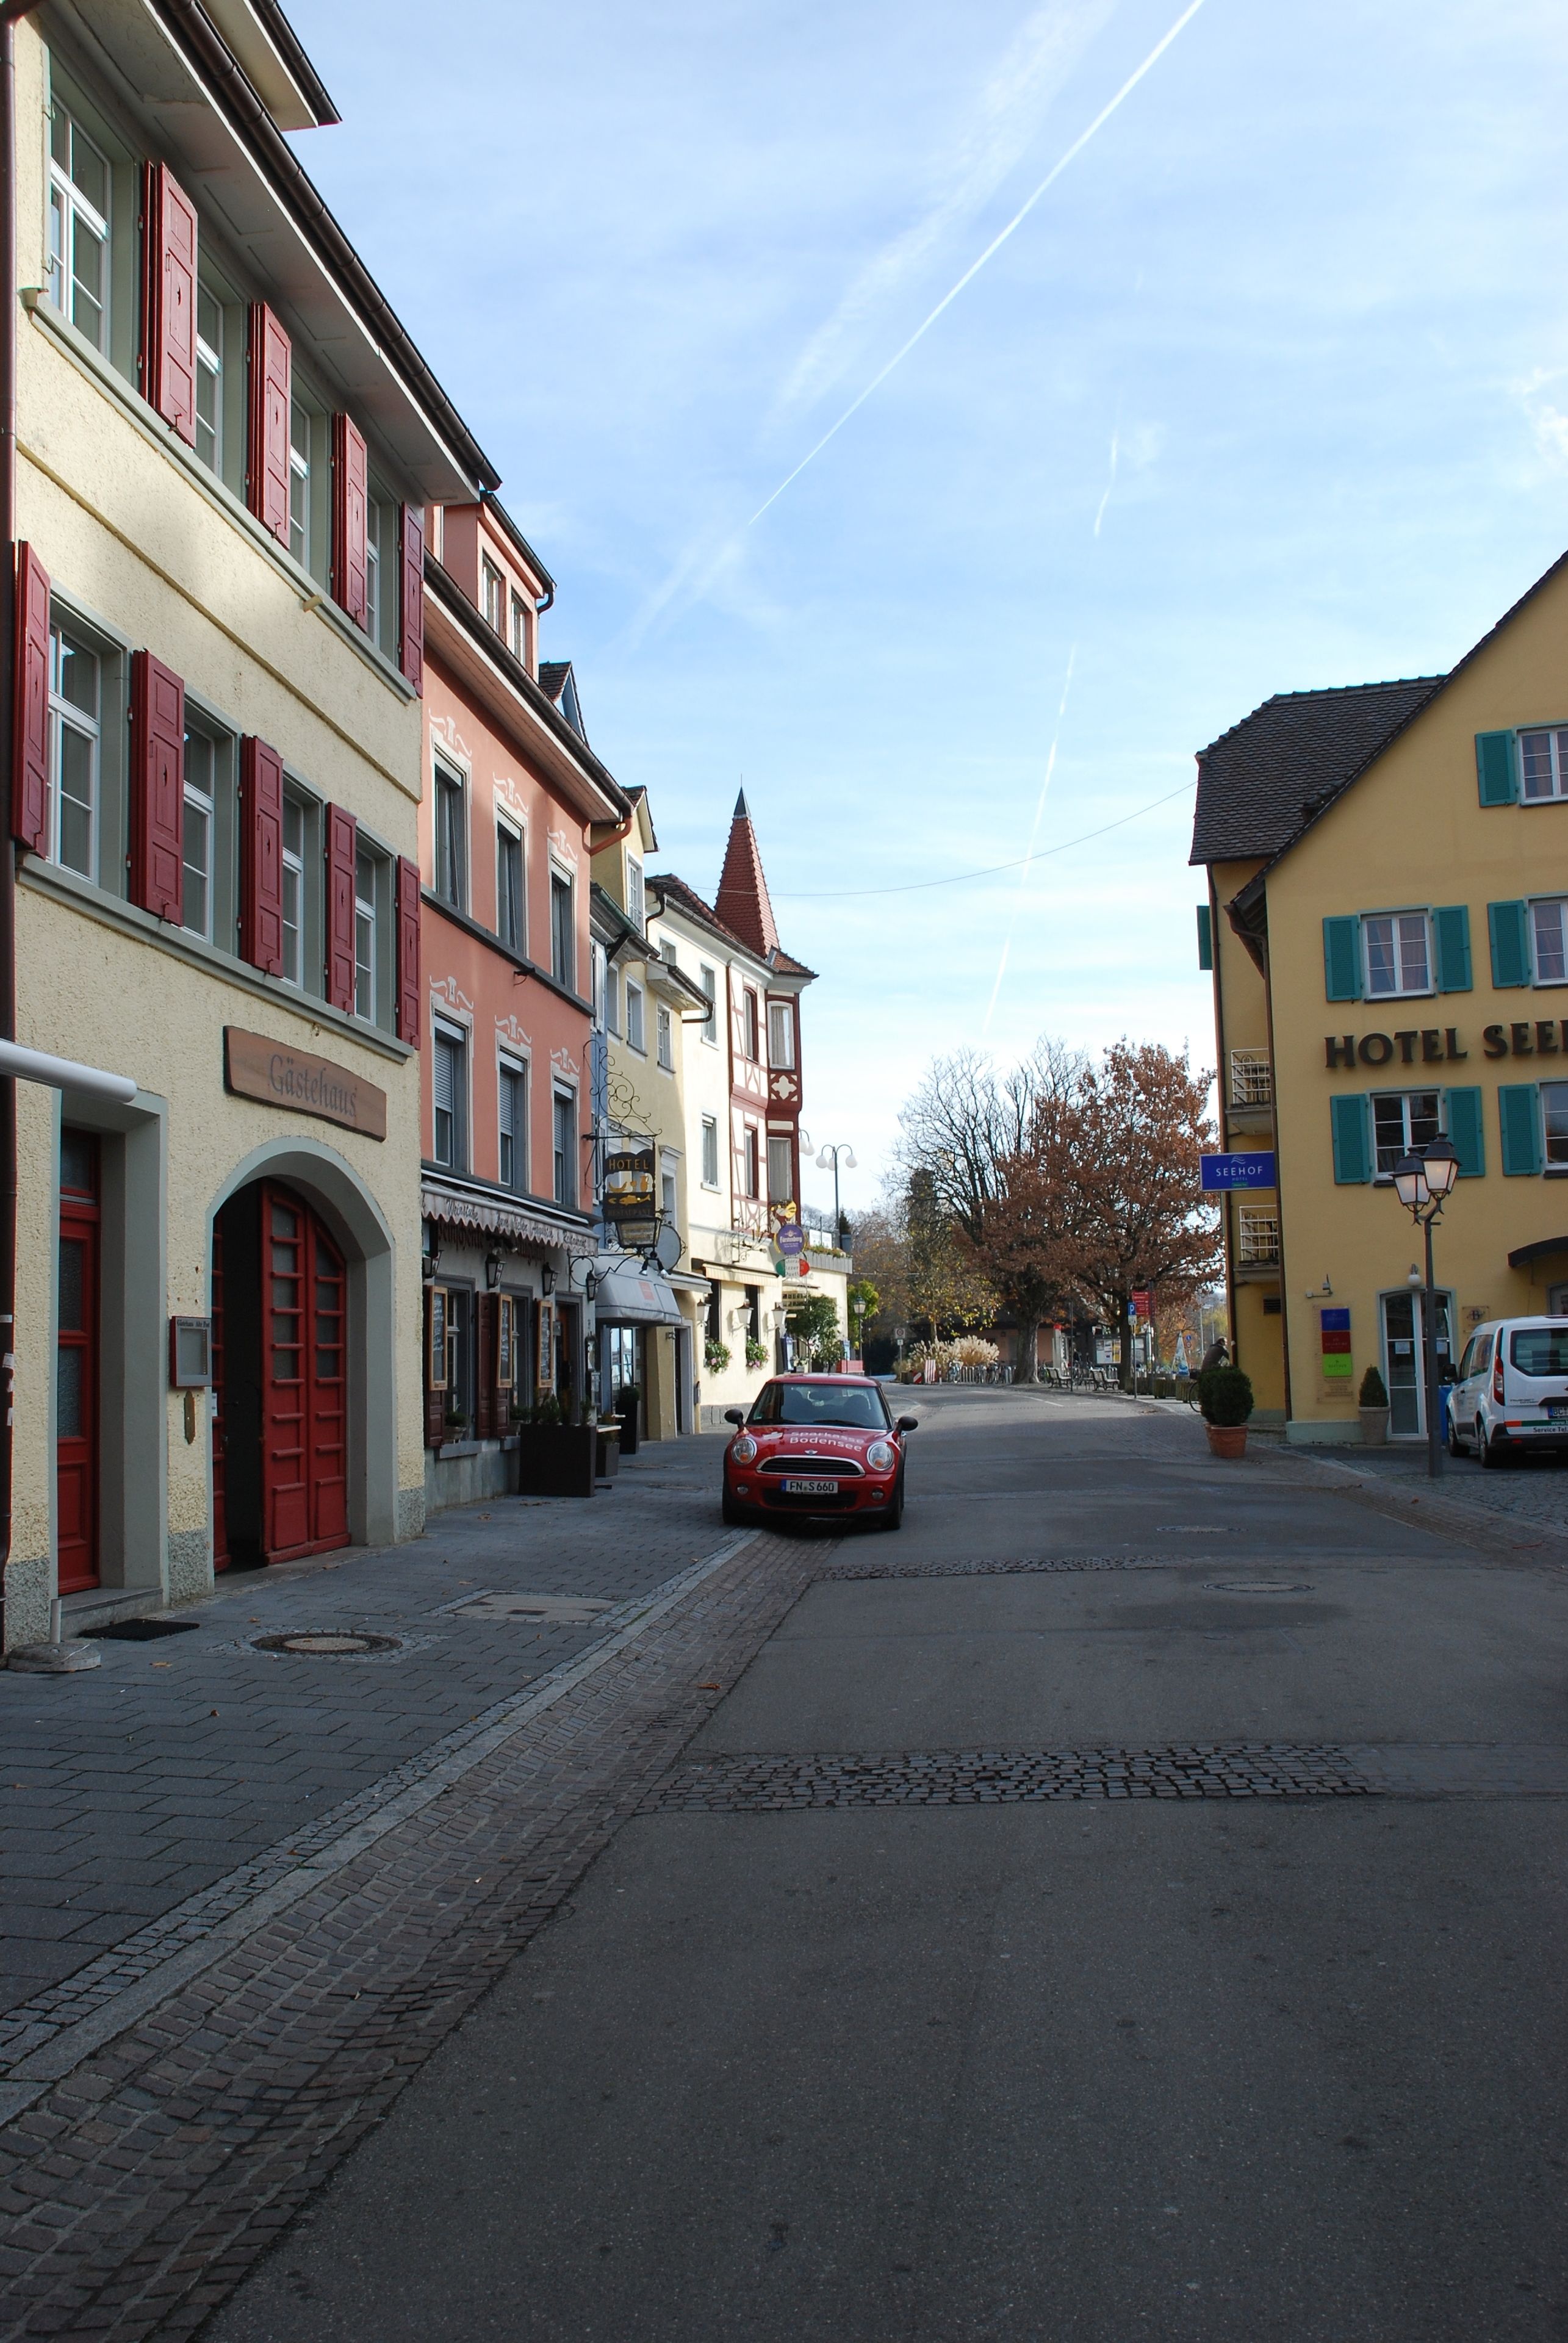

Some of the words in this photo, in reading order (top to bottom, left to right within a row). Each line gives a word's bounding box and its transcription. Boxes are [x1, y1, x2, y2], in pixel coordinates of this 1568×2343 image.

[1324, 1028, 1468, 1068] HOTEL
[270, 1054, 356, 1117] Gästehaus
[609, 1159, 649, 1170] HOTEL
[1216, 1166, 1263, 1176] SEEHOF
[1129, 1304, 1135, 1314] P
[791, 1431, 865, 1444] Sparkasse
[789, 1436, 862, 1452] Bodensee
[789, 1481, 803, 1491] FN
